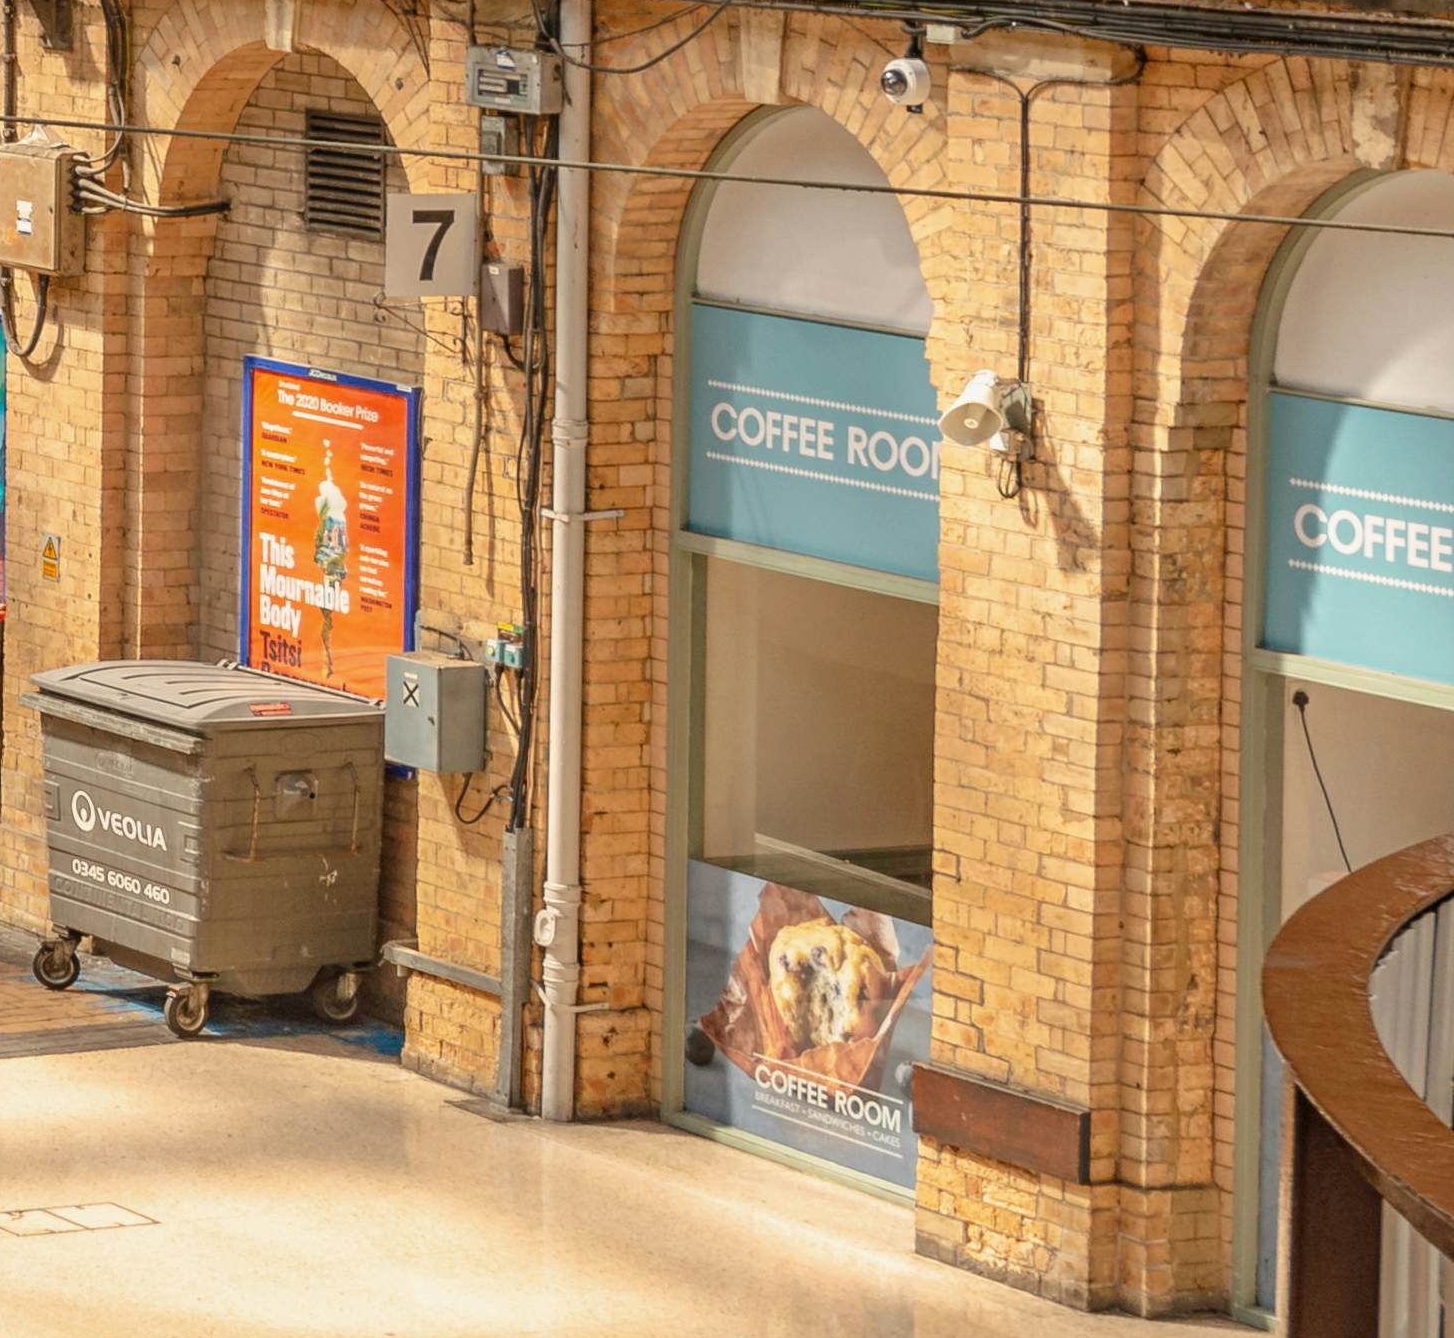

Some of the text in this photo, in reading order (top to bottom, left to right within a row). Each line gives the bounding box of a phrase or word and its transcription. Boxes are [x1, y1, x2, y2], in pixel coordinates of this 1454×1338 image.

[411, 210, 455, 282] 7
[278, 390, 378, 423] The 2020 Booker Prize
[710, 401, 835, 462] COFFEE
[259, 533, 294, 569] This
[1294, 503, 1452, 572] COFFEE
[260, 563, 350, 614] Mournable
[260, 594, 301, 638] Body
[260, 630, 301, 667] Tsitsi
[97, 807, 167, 851] VEOLIA
[72, 859, 104, 883] 0345
[108, 871, 141, 894] 6060
[144, 884, 169, 904] 460
[755, 1064, 900, 1133] COFFEE ROOM
[755, 1091, 901, 1148] BREAKFAST SANDWICHES CAKES
